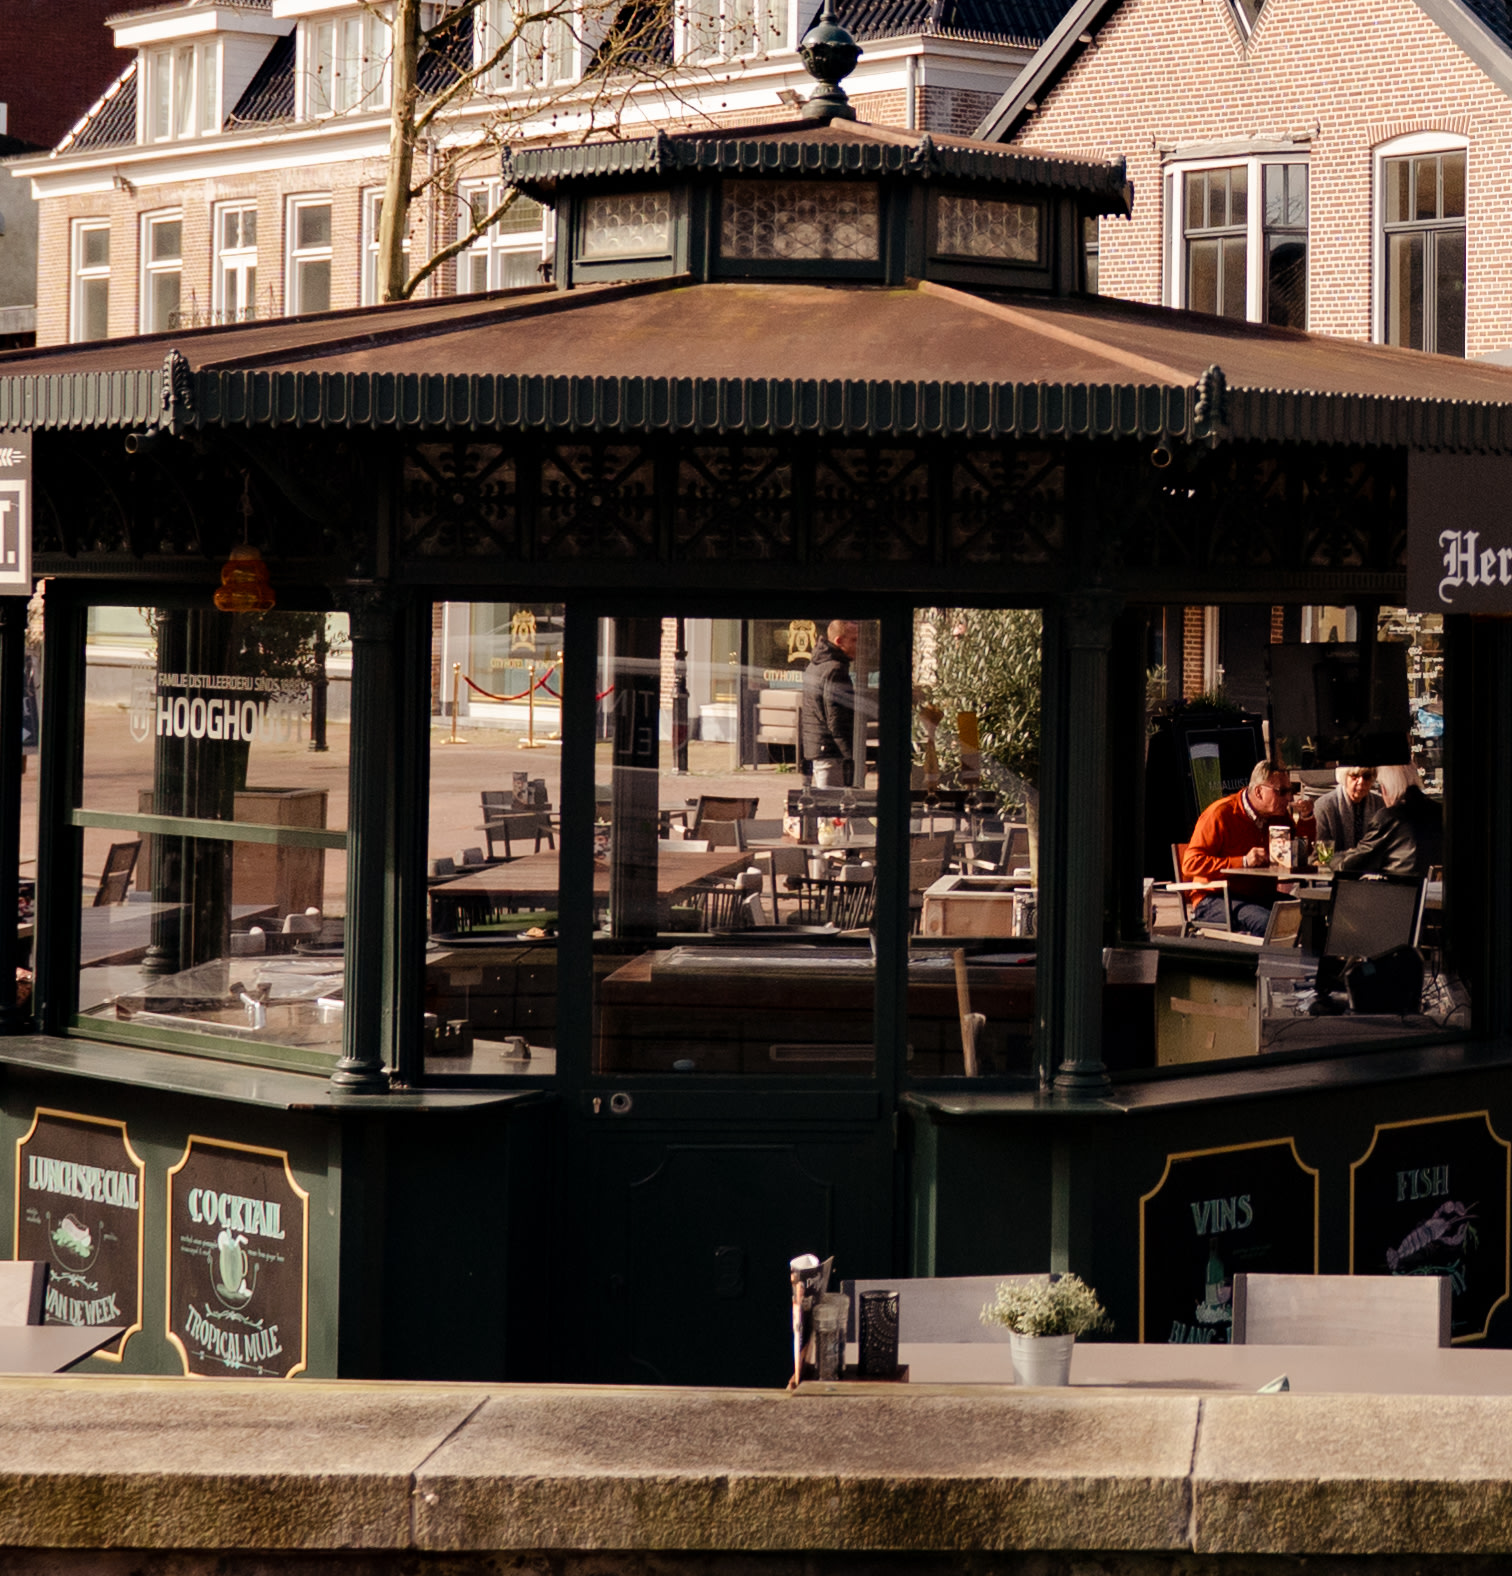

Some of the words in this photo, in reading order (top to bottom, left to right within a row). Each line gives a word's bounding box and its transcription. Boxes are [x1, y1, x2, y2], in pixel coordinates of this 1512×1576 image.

[29, 1155, 139, 1210] LUNCHSPECIAL
[1397, 1164, 1449, 1202] FISH
[188, 1187, 285, 1240] COCKTAIL
[1190, 1194, 1253, 1236] VINS
[46, 1286, 68, 1321] VAN
[85, 1292, 122, 1326] WEEK
[184, 1304, 244, 1363] TROPICAL
[244, 1325, 283, 1364] MULE
